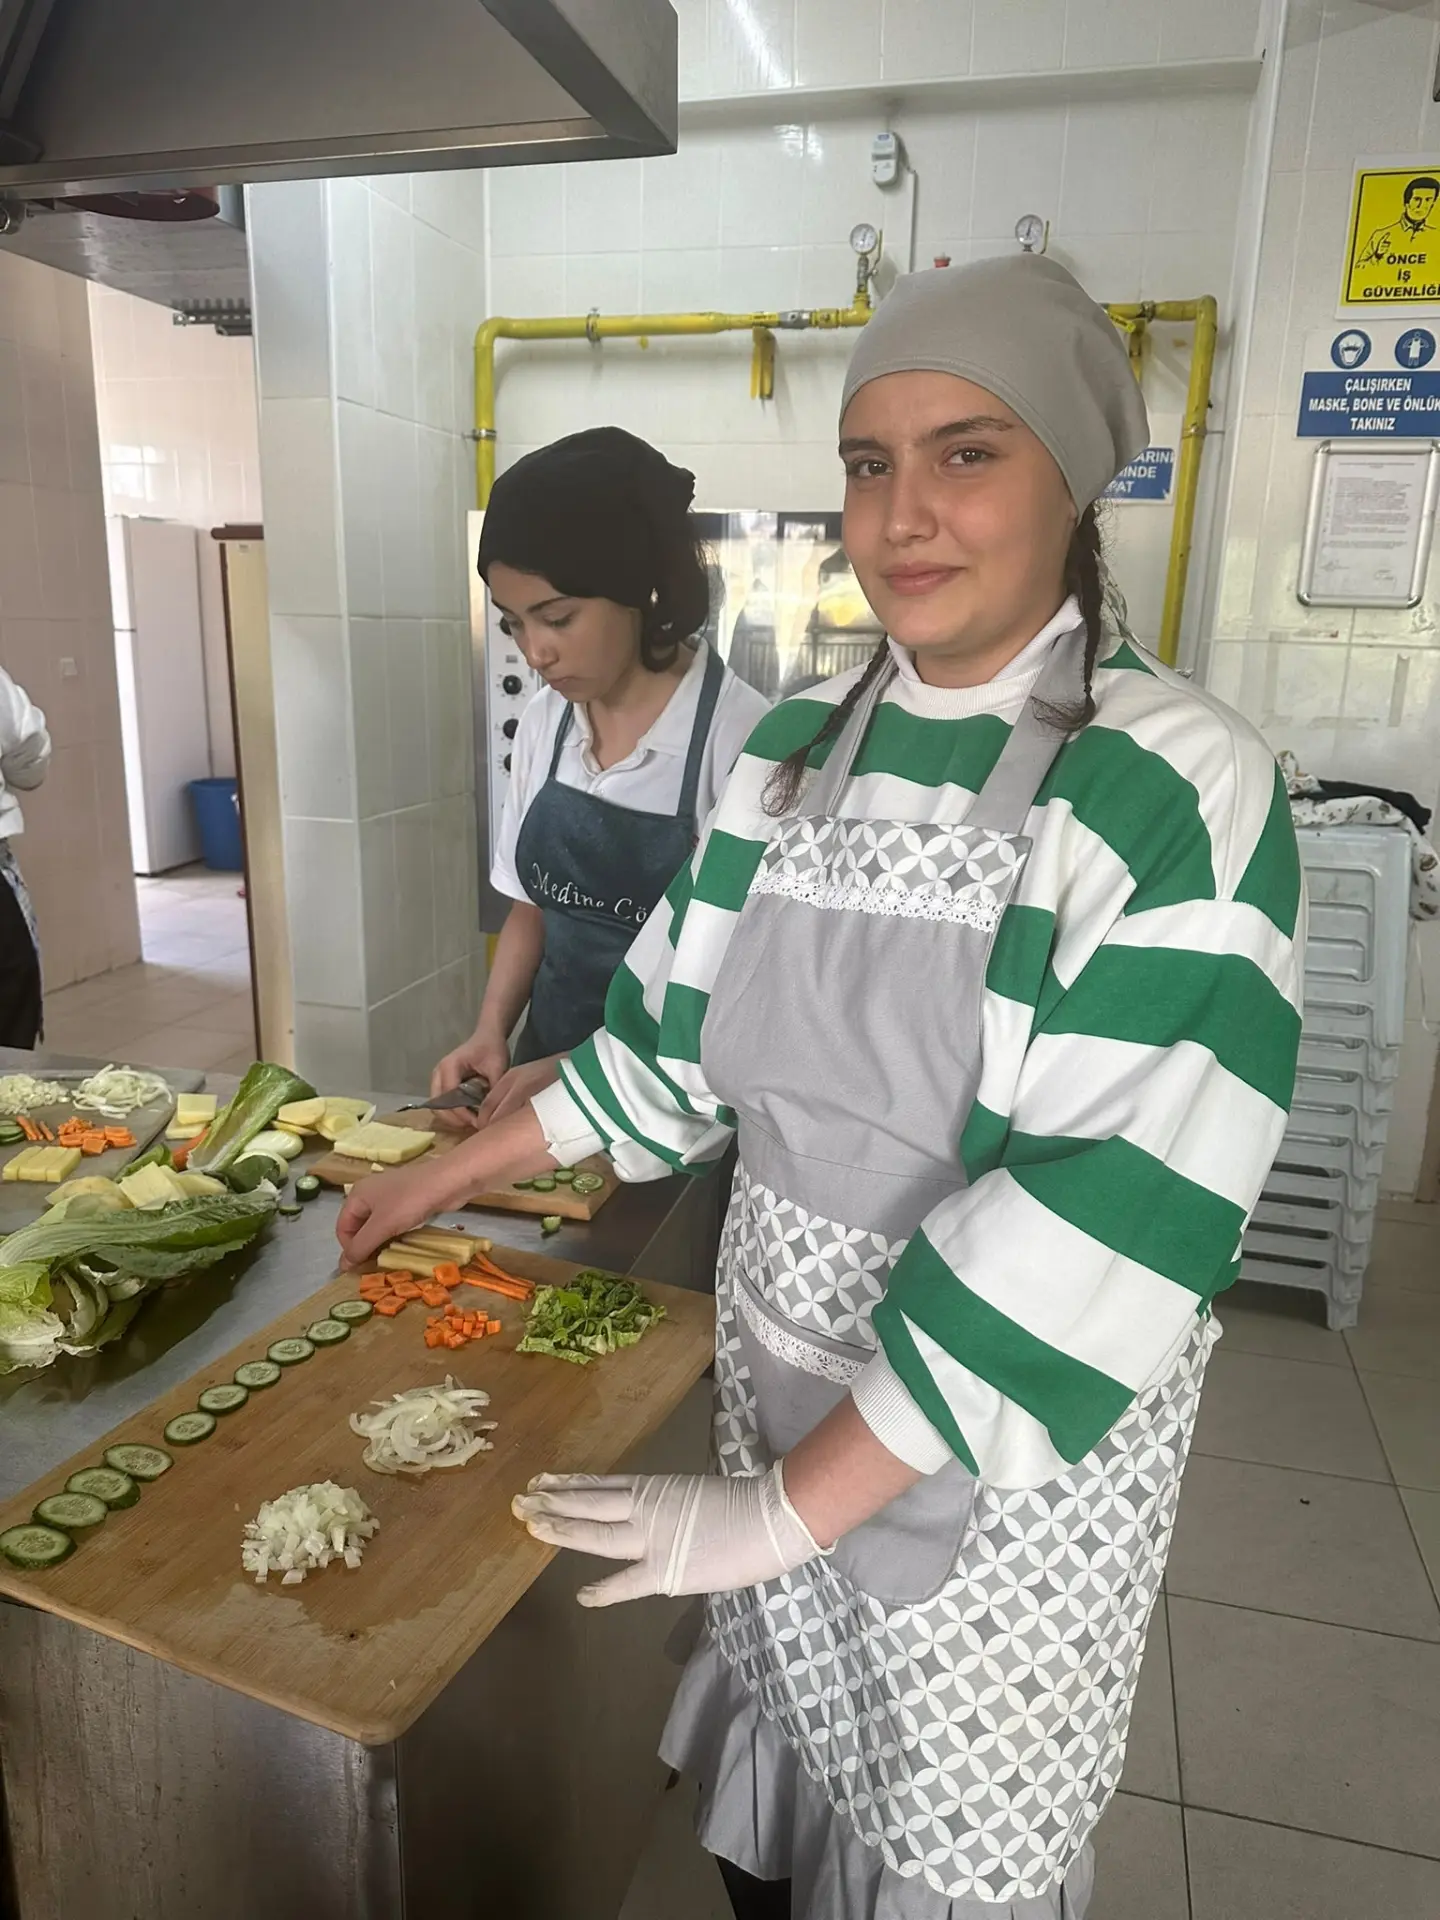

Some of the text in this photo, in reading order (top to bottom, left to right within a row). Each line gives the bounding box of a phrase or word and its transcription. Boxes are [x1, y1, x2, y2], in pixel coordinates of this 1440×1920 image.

[1386, 253, 1427, 265] ÖNCE
[1397, 268, 1412, 283] İŞ
[1345, 378, 1412, 394] ÇALIŞIRKEN
[1308, 398, 1350, 414] MASKE,
[1353, 398, 1383, 411] BONE
[1386, 398, 1401, 411] VE
[1350, 418, 1396, 430] TAKINIZ
